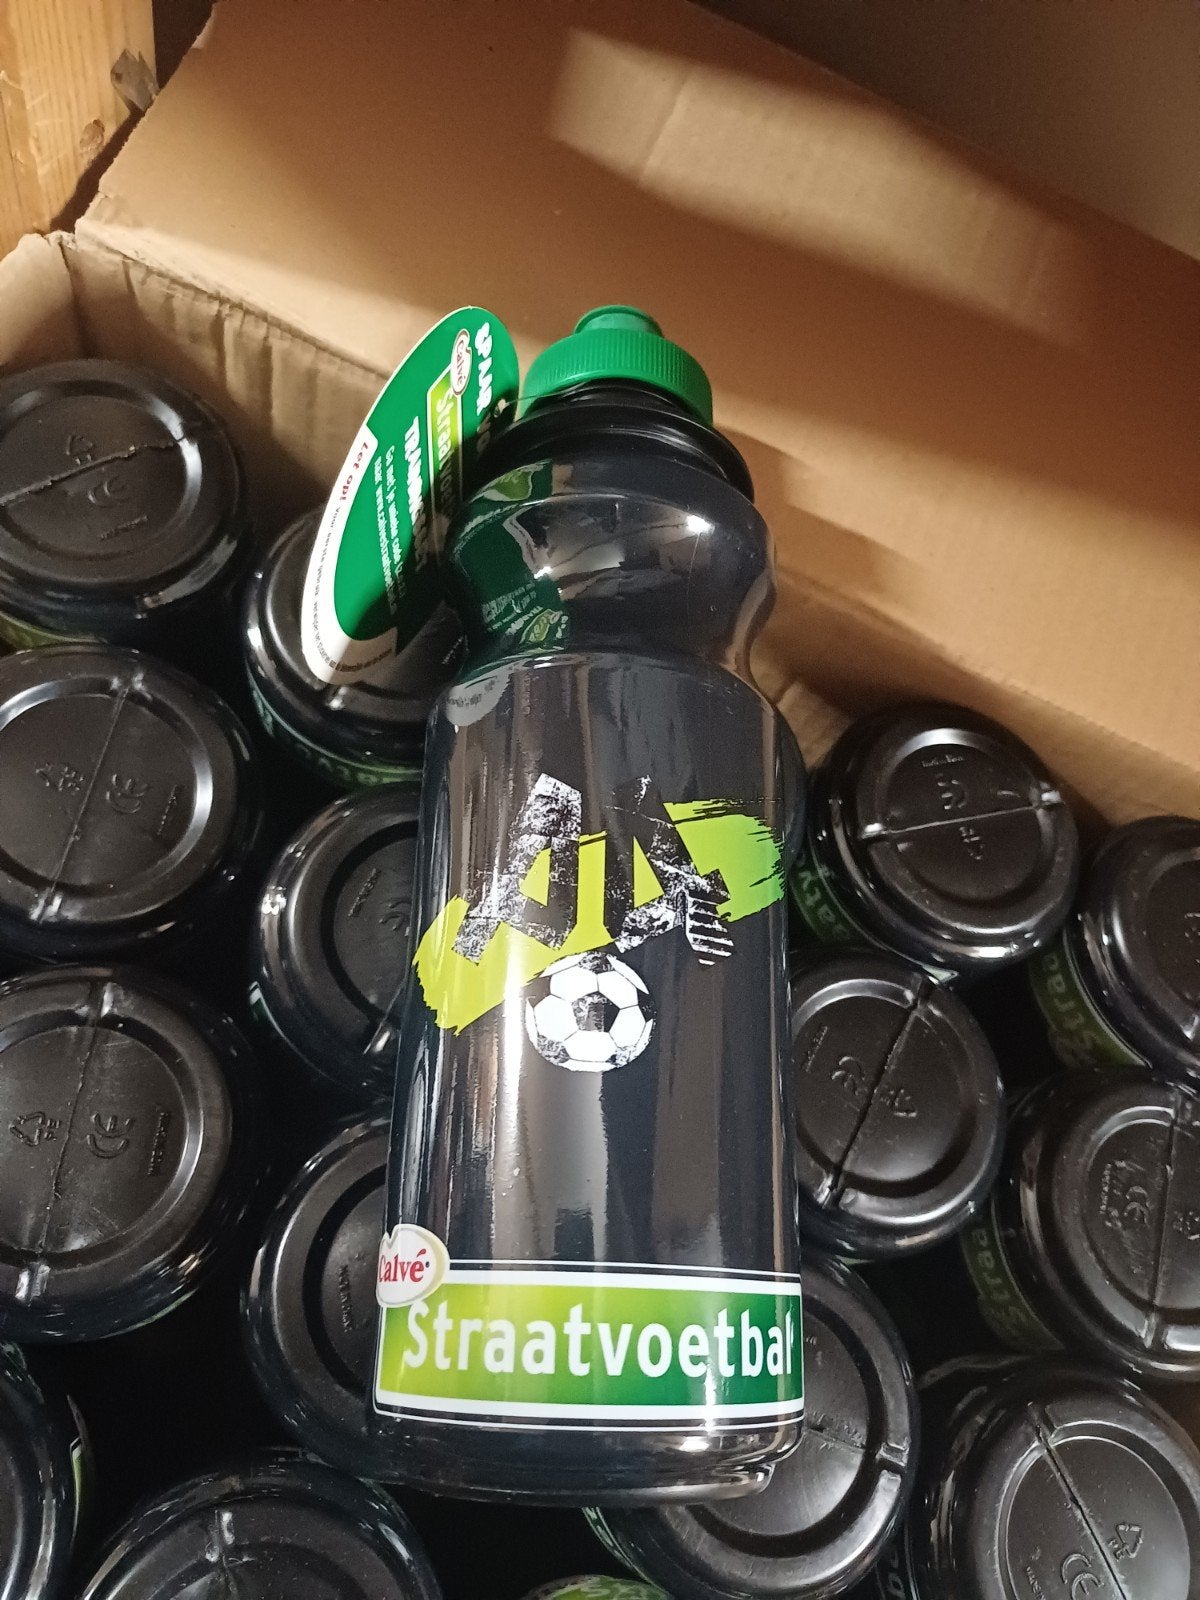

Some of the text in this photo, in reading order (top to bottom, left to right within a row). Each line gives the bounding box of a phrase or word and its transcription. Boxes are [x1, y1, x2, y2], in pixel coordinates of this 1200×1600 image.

[353, 442, 368, 470] Let
[378, 1248, 428, 1284] Calvé
[403, 1300, 793, 1379] Straatvoetbal
